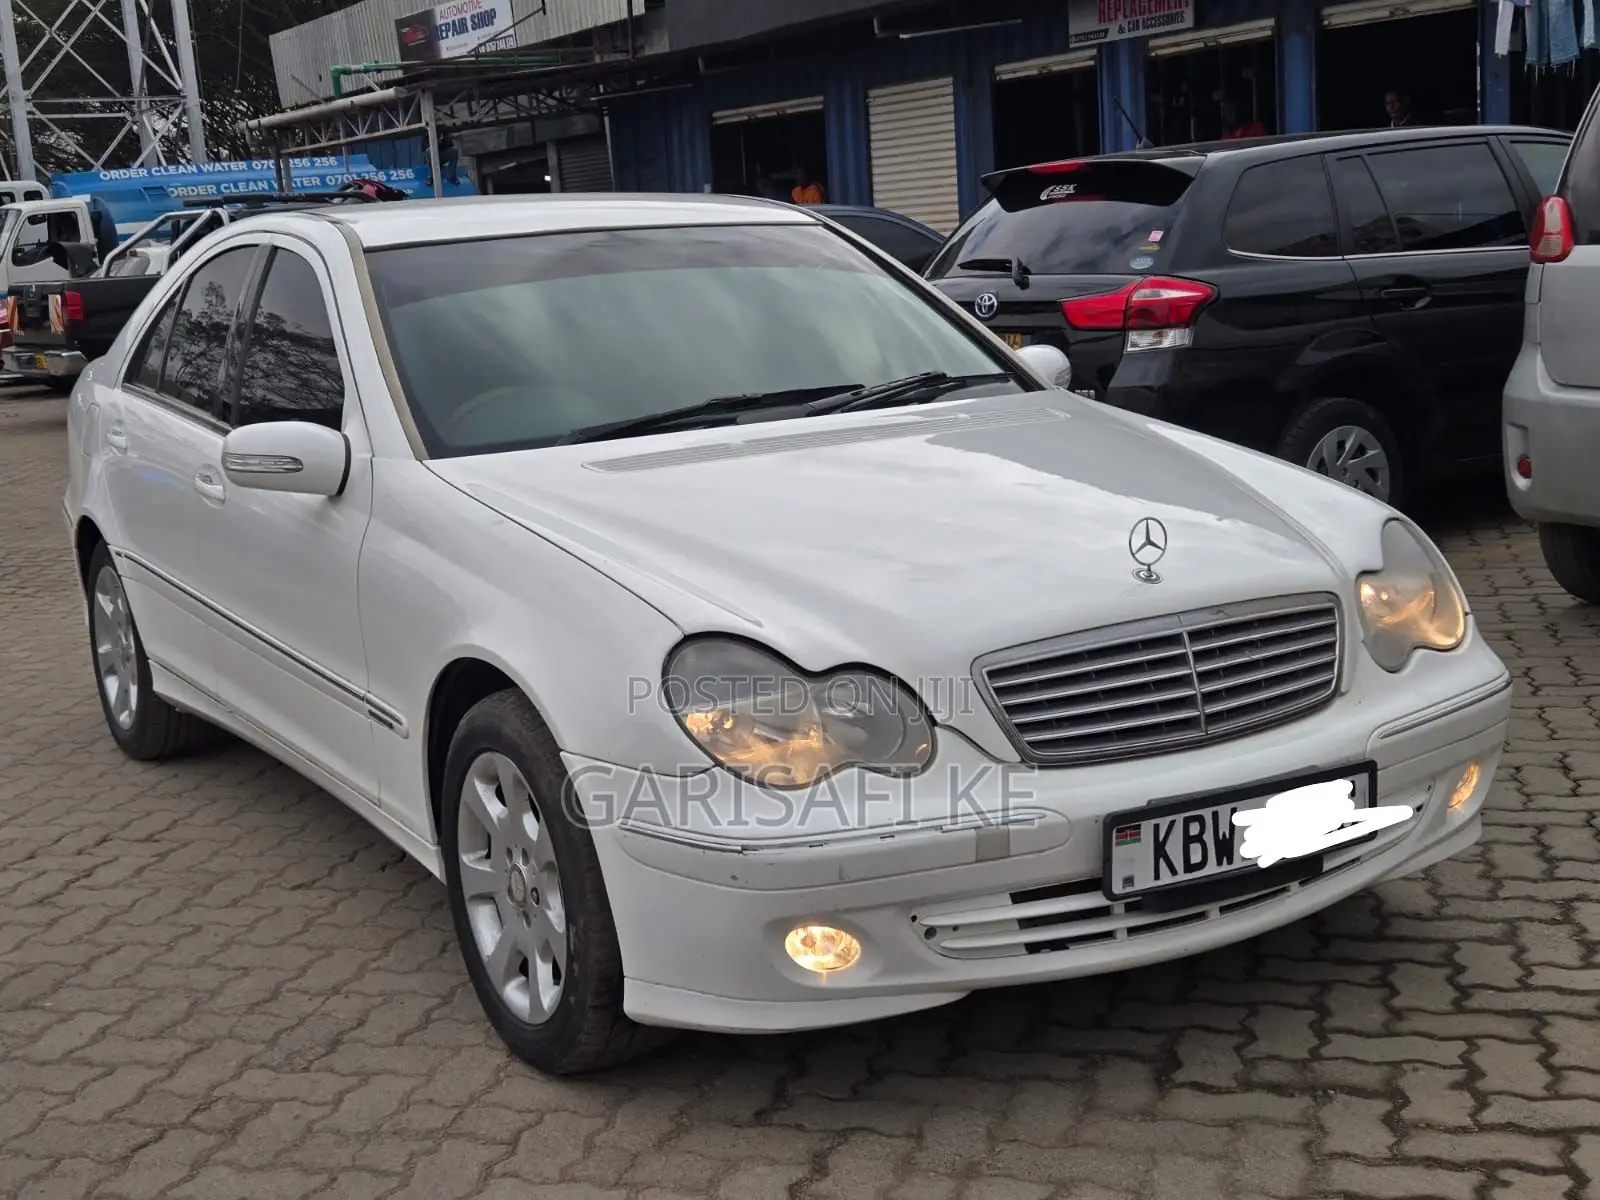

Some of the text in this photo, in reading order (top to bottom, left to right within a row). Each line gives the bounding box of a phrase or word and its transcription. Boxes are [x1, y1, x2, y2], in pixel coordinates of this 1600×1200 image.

[440, 0, 483, 20] AUTOMOTIVE
[470, 8, 497, 31] SHOP
[1118, 11, 1185, 33] & CAR ACCESSORIES
[100, 168, 148, 181] ORDER
[152, 164, 197, 176] CLEAN
[200, 160, 248, 173] WATER
[289, 157, 310, 168] 256
[315, 156, 338, 167] 256
[168, 184, 217, 198] ORDER
[220, 180, 268, 195] CLEAN
[390, 169, 415, 180] 256
[1153, 806, 1238, 881] KBW
